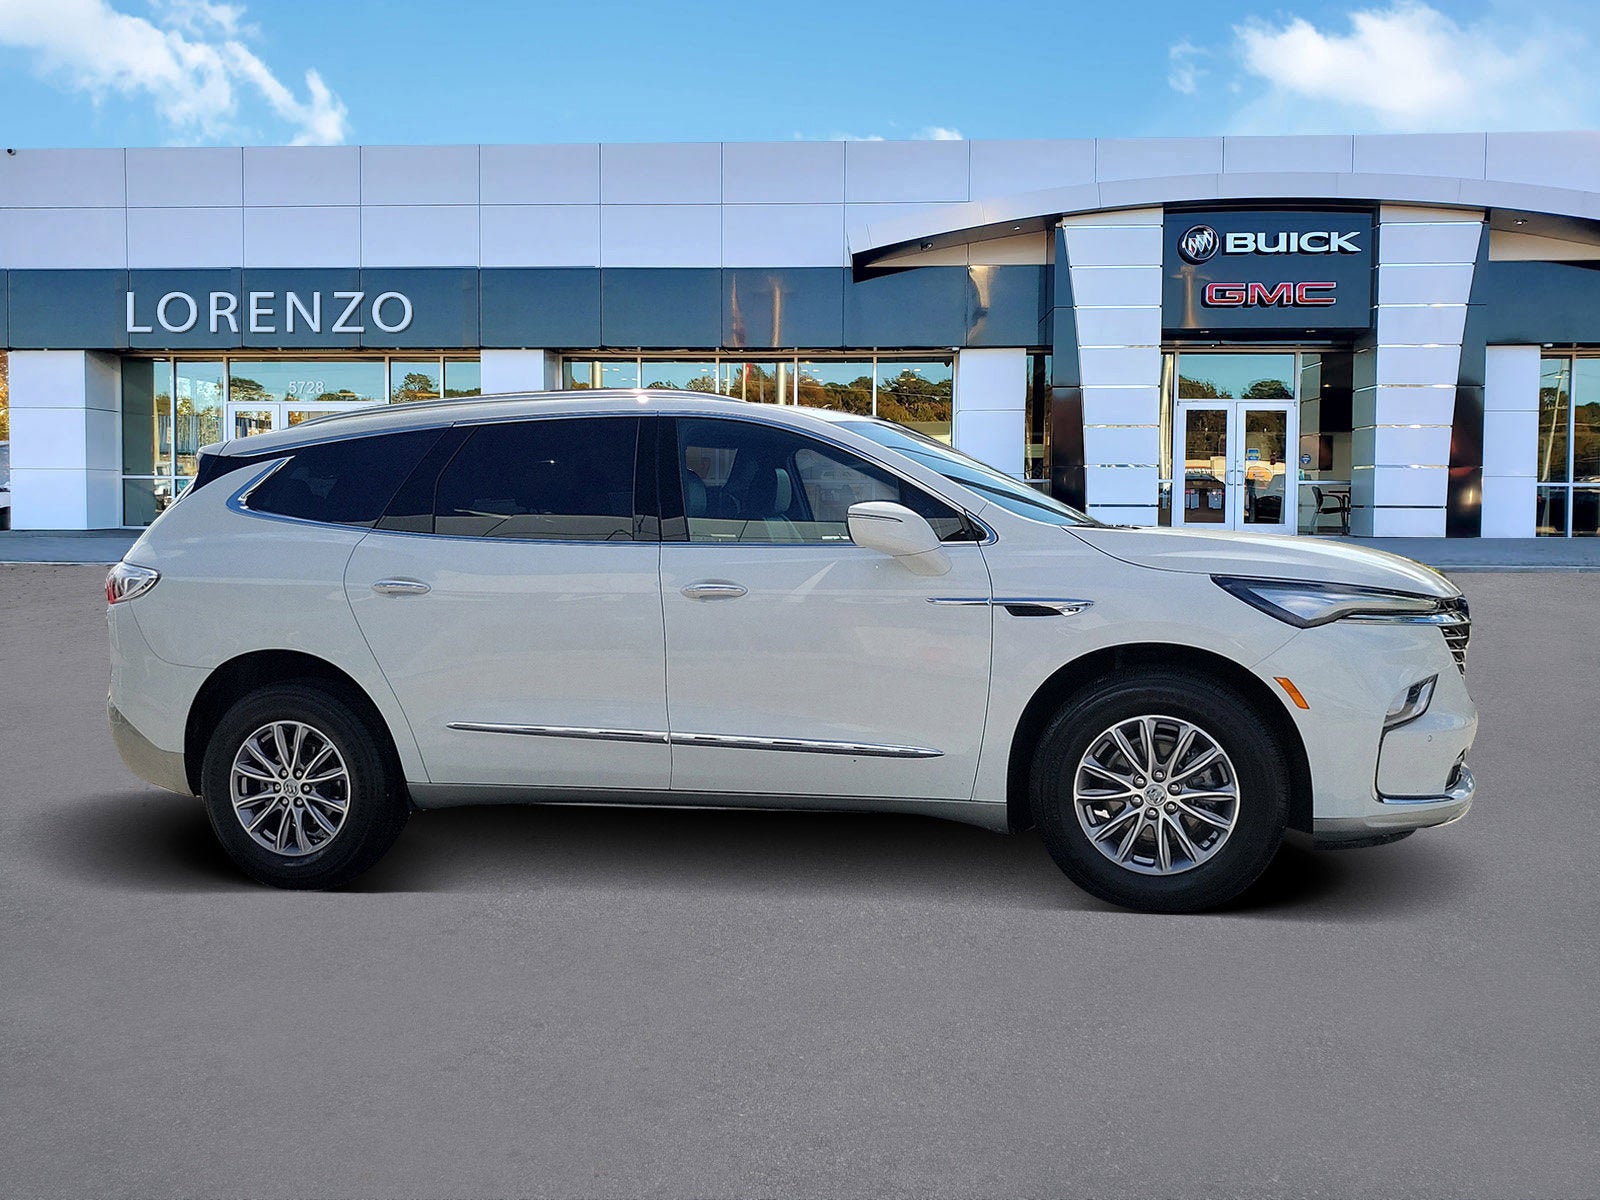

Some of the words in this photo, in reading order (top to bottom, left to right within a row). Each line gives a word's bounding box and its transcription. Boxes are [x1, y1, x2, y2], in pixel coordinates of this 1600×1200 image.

[1225, 231, 1362, 253] BUICK
[1205, 281, 1337, 305] GMC
[126, 291, 413, 333] LORENZO
[288, 381, 325, 394] 5728
